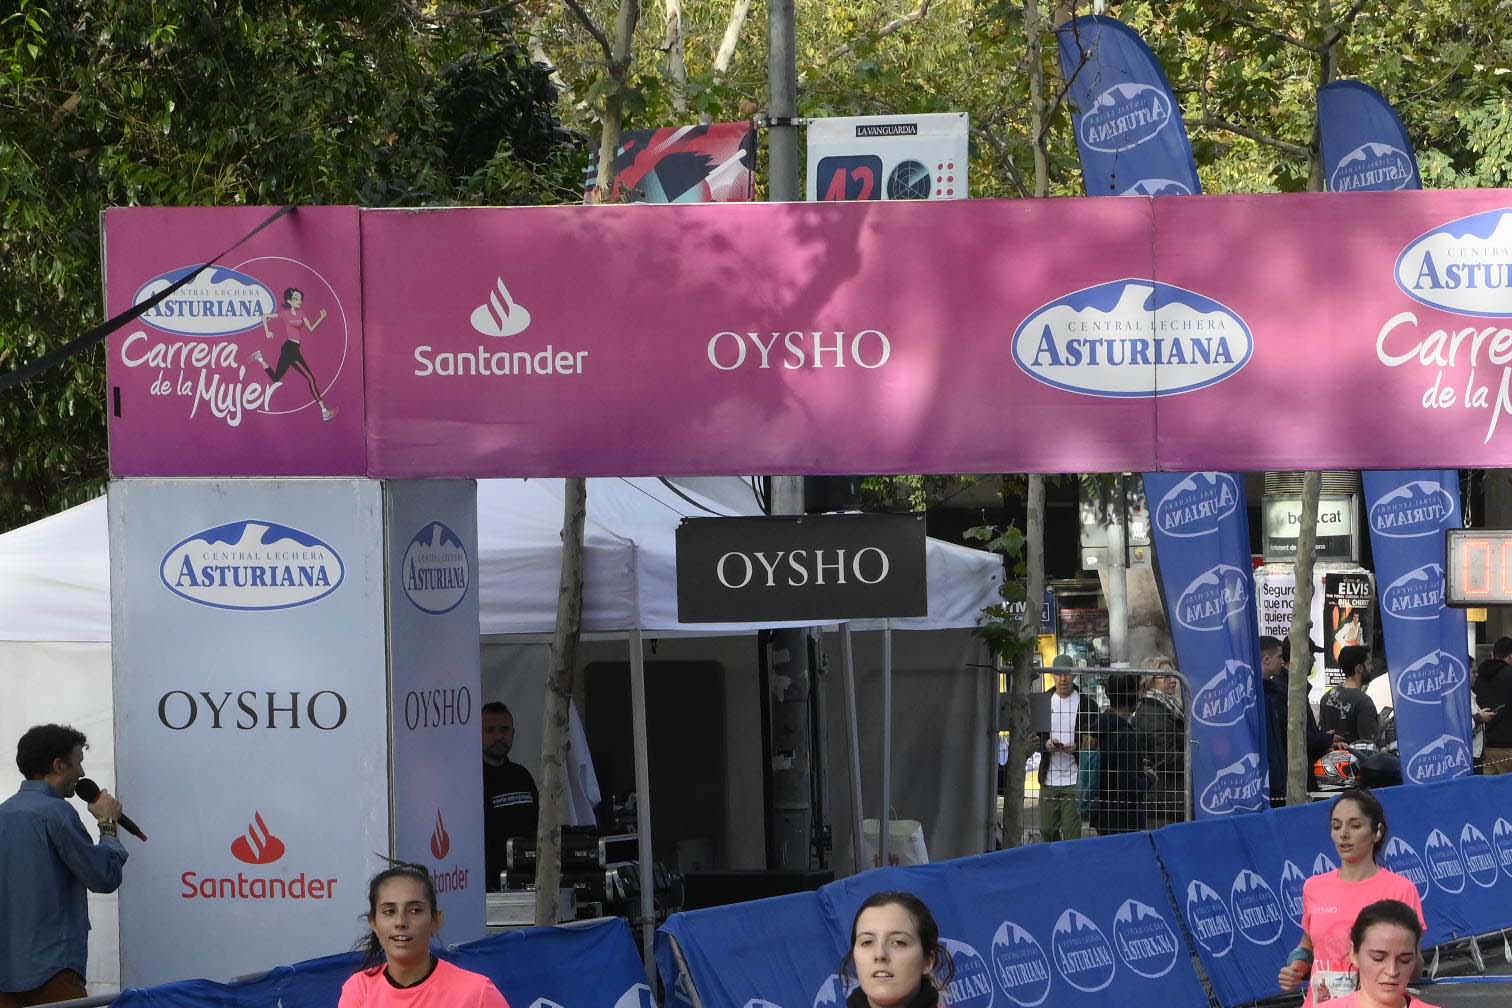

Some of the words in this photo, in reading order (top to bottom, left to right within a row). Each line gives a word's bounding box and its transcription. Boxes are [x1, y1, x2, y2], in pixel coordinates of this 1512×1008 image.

[868, 124, 916, 135] VANGUARDIA
[144, 291, 264, 318] ASTURIANA
[172, 288, 209, 297] ENTRAL
[1067, 321, 1143, 332] CENTRAL
[1150, 319, 1226, 331] LECHERA
[121, 331, 239, 368] Carrera
[414, 344, 589, 376] Santander
[707, 329, 892, 371] OYSHO
[1031, 323, 1235, 367] ASTURIANA
[150, 370, 172, 395] de
[178, 368, 193, 396] la
[190, 365, 283, 427] Mujer
[1422, 369, 1457, 409] de
[1464, 368, 1489, 409] la
[1287, 510, 1342, 525] b.cat
[175, 554, 331, 588] ASTURIANA
[203, 551, 260, 561] CENTRAL
[266, 550, 326, 561] LECHERA
[716, 548, 890, 589] OYSHO
[407, 556, 466, 592] ASTURIANA
[1338, 582, 1369, 595] ELVIS
[158, 690, 348, 731] OYSHO
[404, 685, 472, 731] OYSHO
[180, 870, 338, 900] Santander
[1000, 956, 1048, 989] ASTURIANA
[1059, 943, 1112, 975] ASTURIANA
